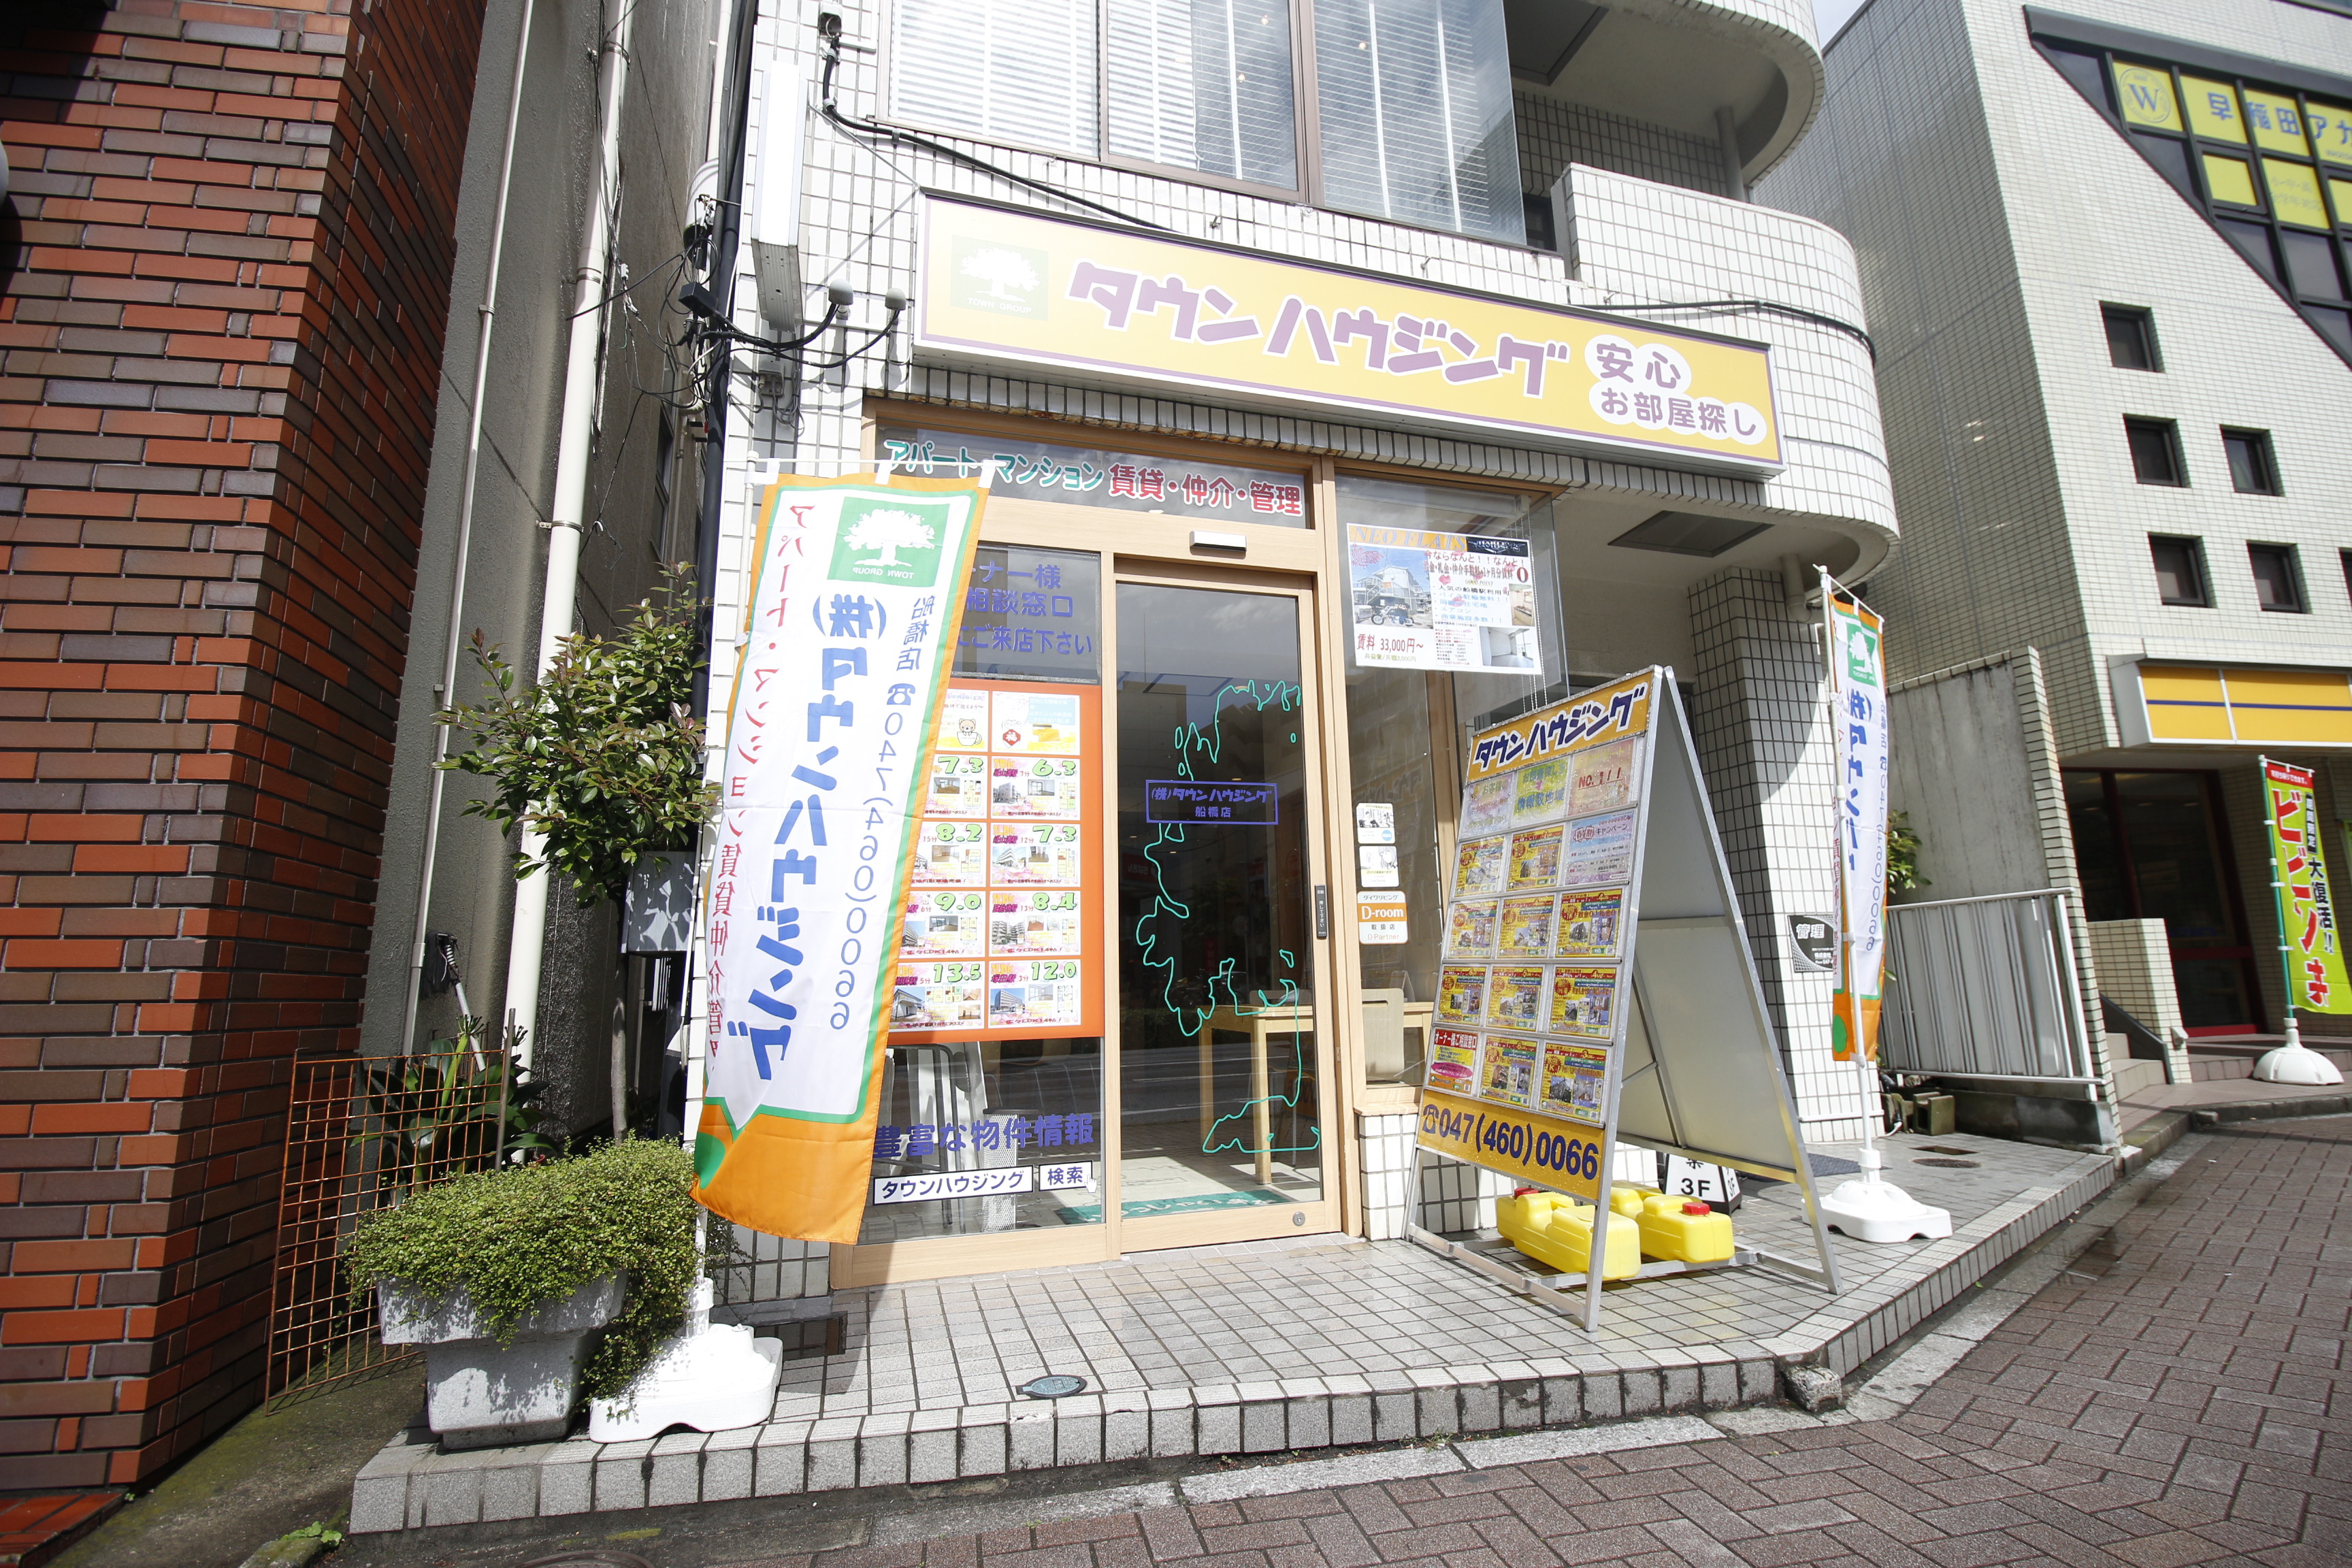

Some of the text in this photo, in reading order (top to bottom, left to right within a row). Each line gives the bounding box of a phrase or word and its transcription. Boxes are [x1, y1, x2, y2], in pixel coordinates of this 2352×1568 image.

[2127, 83, 2161, 112] W
[967, 297, 1032, 314] TOWN GROUP
[1067, 261, 1568, 397] タウンハウジング
[1596, 342, 1681, 389] 安心
[1601, 387, 1757, 436] お部屋探し
[1350, 526, 1466, 551] NEO FLATS
[1005, 731, 1017, 742] 福
[1475, 686, 1646, 769] タウンハウジング
[938, 755, 984, 774] 7.3
[1032, 759, 1076, 777] 6.3
[1195, 806, 1231, 818] 船橋店
[935, 823, 983, 842] 8.2
[1032, 825, 1077, 843] 7.3
[934, 892, 982, 911] 9.0
[1032, 892, 1075, 911] 8.4
[1361, 905, 1405, 920] D-room
[1795, 923, 1825, 940] 管理
[933, 963, 981, 983] 13.5
[1031, 962, 1077, 981] 12.0
[872, 1113, 1094, 1158] 豊富な物件情報
[1438, 1108, 1599, 1180] 047(460)0066
[882, 1166, 1083, 1199] タウンハウジング 検索
[1680, 1177, 1711, 1197] 3F
